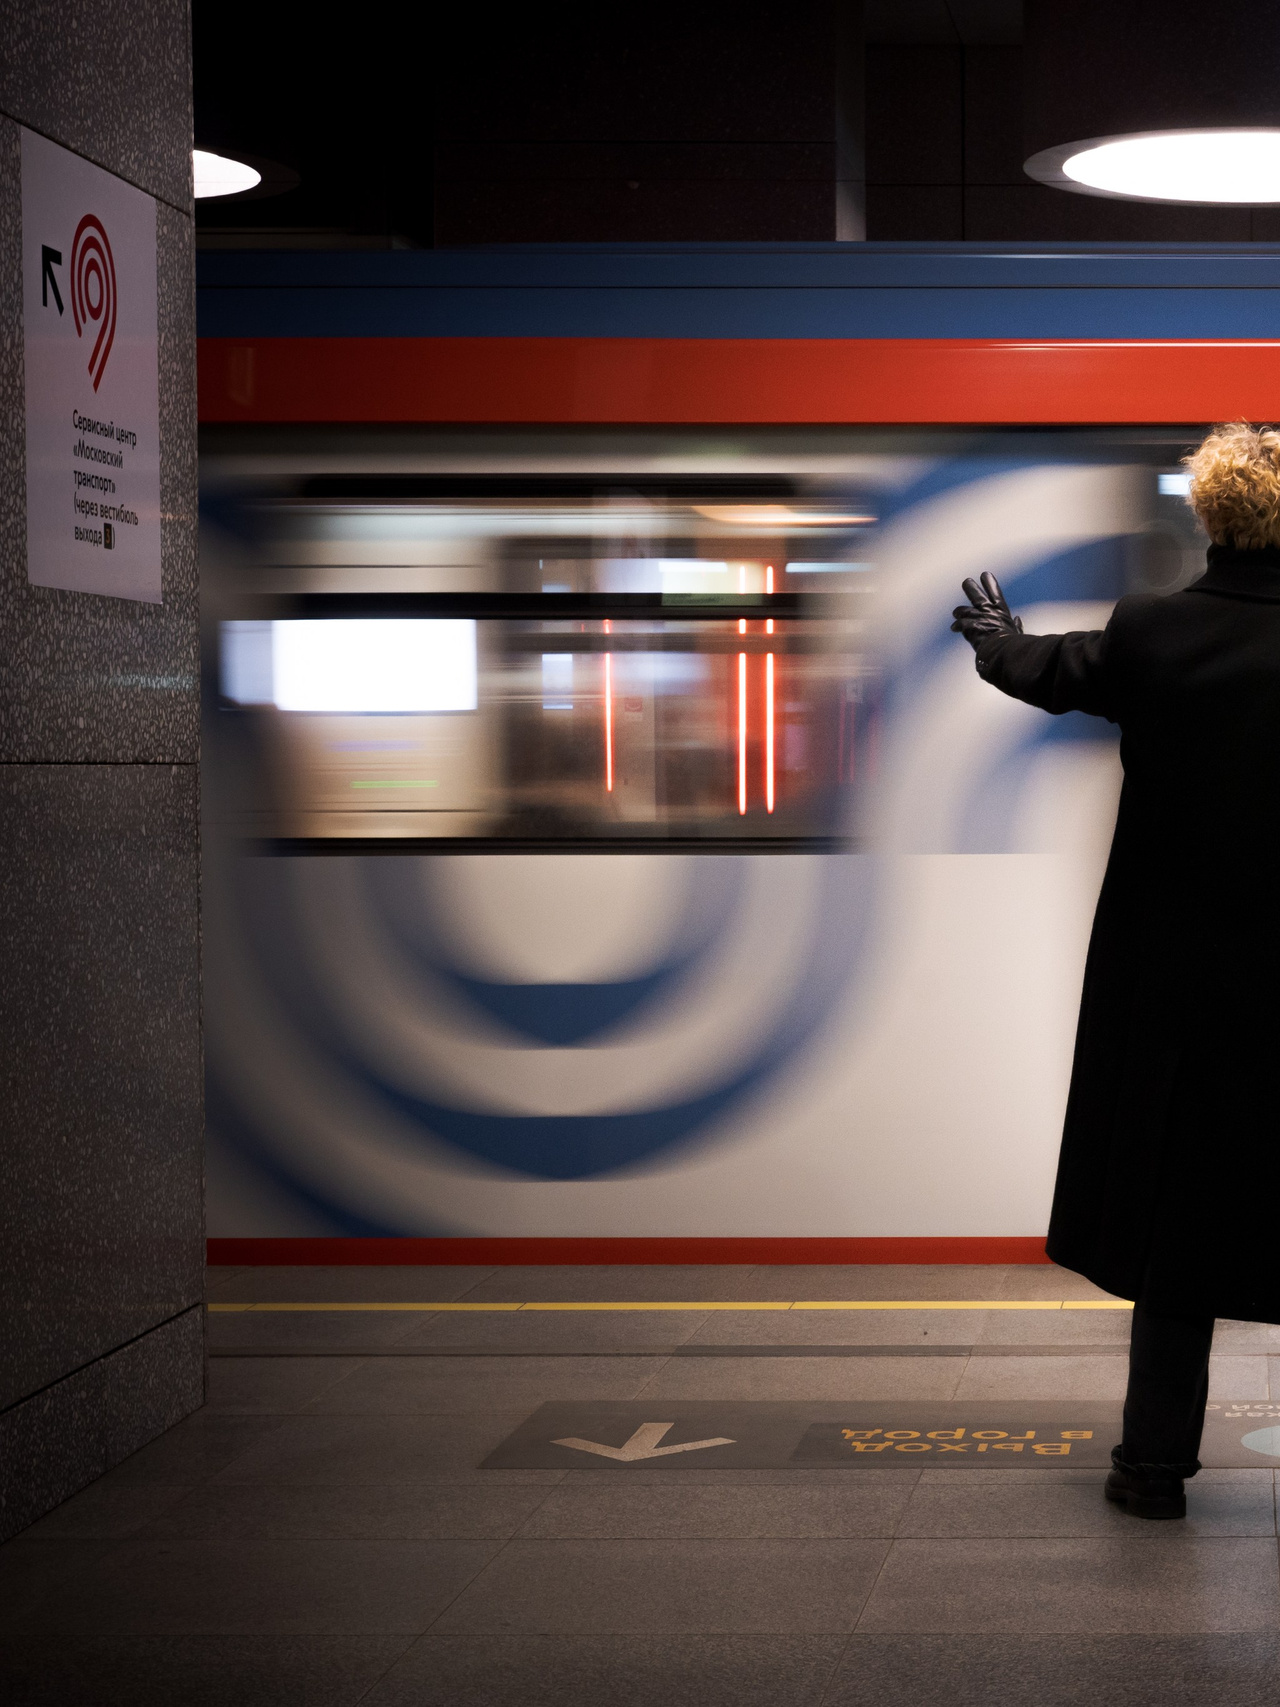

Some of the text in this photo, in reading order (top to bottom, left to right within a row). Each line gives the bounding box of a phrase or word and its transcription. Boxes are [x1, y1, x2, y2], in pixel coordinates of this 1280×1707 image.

[72, 409, 137, 450] Сервисный центр
[73, 438, 123, 469] «Московский
[73, 470, 116, 496] транспорт»
[73, 491, 139, 526] (через вестибюль
[74, 526, 103, 547] выхода
[840, 1427, 1094, 1440] в город
[851, 1441, 1072, 1455] Выход
